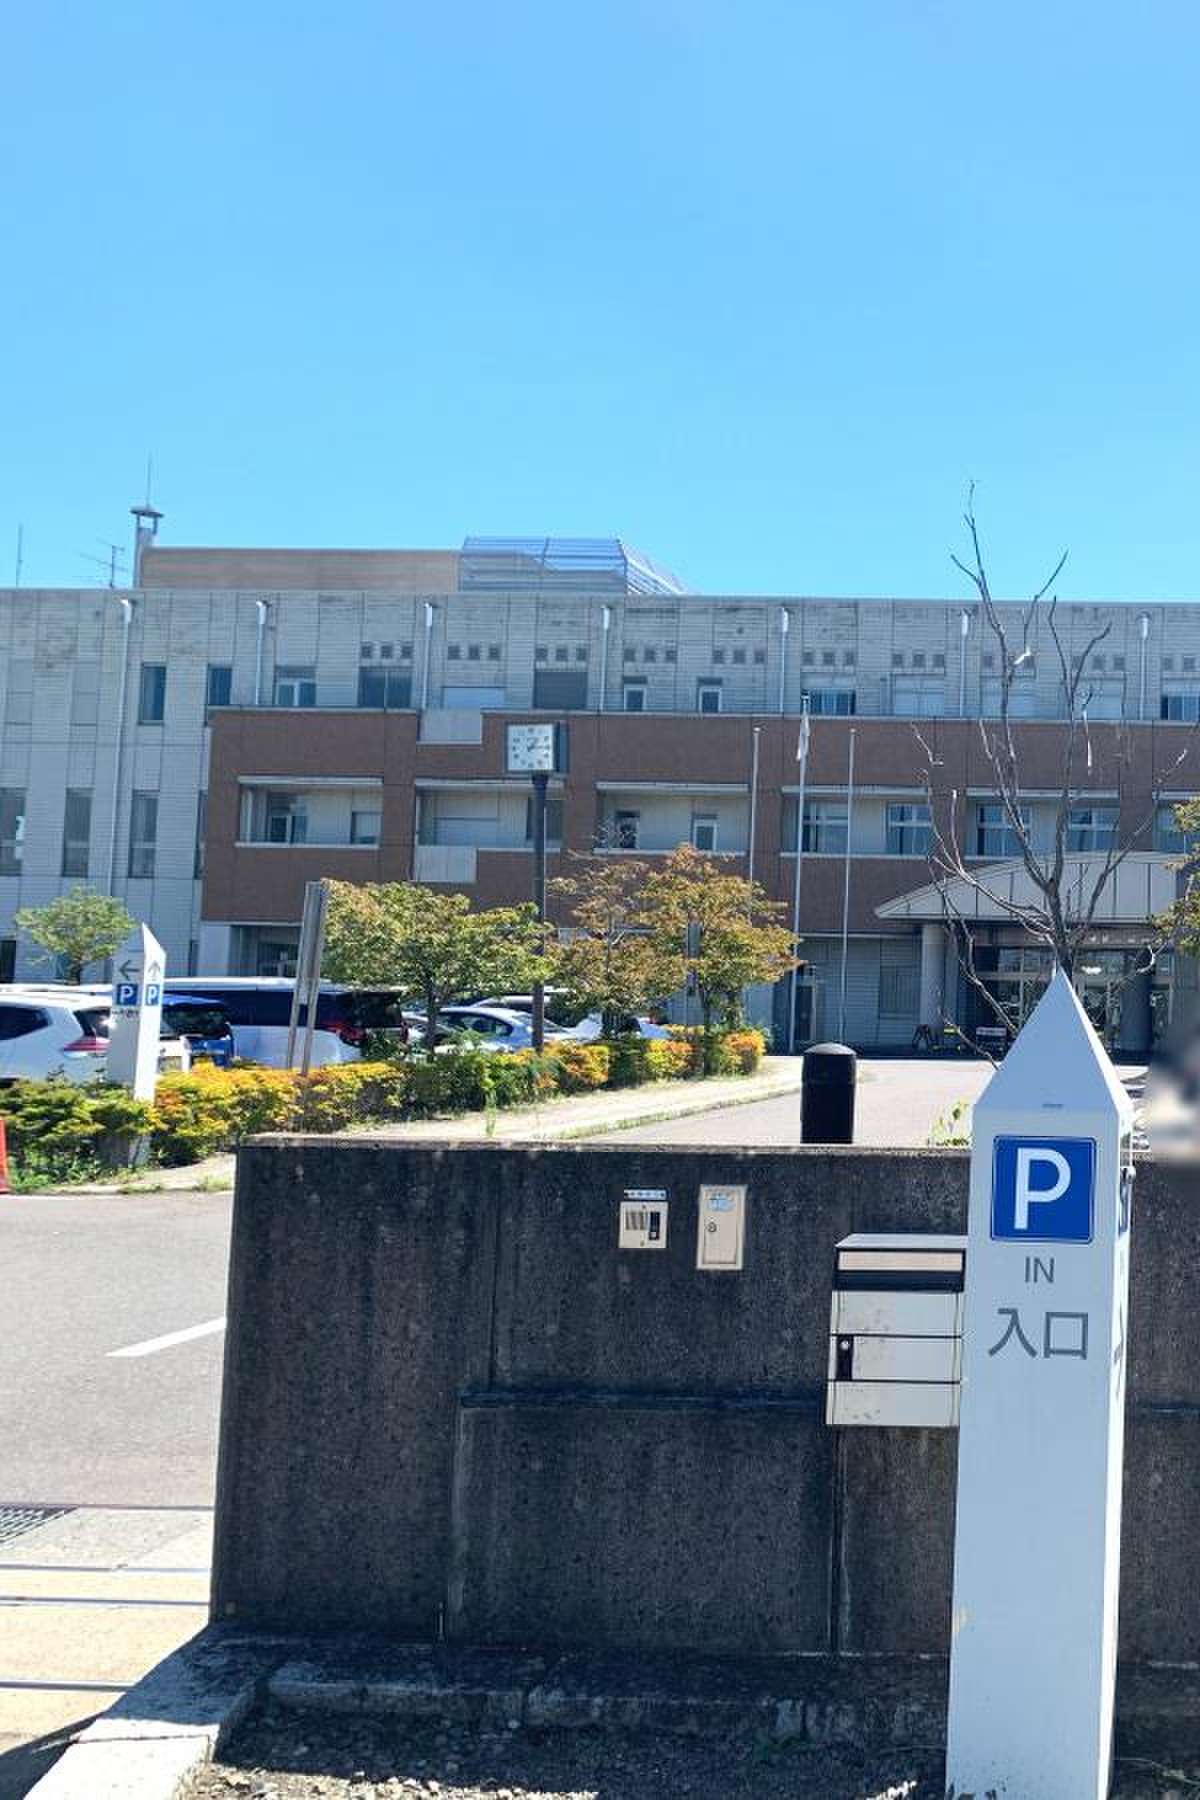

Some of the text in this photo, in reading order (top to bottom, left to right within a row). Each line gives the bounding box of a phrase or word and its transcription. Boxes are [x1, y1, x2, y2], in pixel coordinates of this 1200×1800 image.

[119, 985, 134, 1004] P
[147, 985, 158, 1005] P
[1013, 1147, 1071, 1230] P
[1024, 1256, 1055, 1284] IN
[987, 1307, 1089, 1361] 入口
